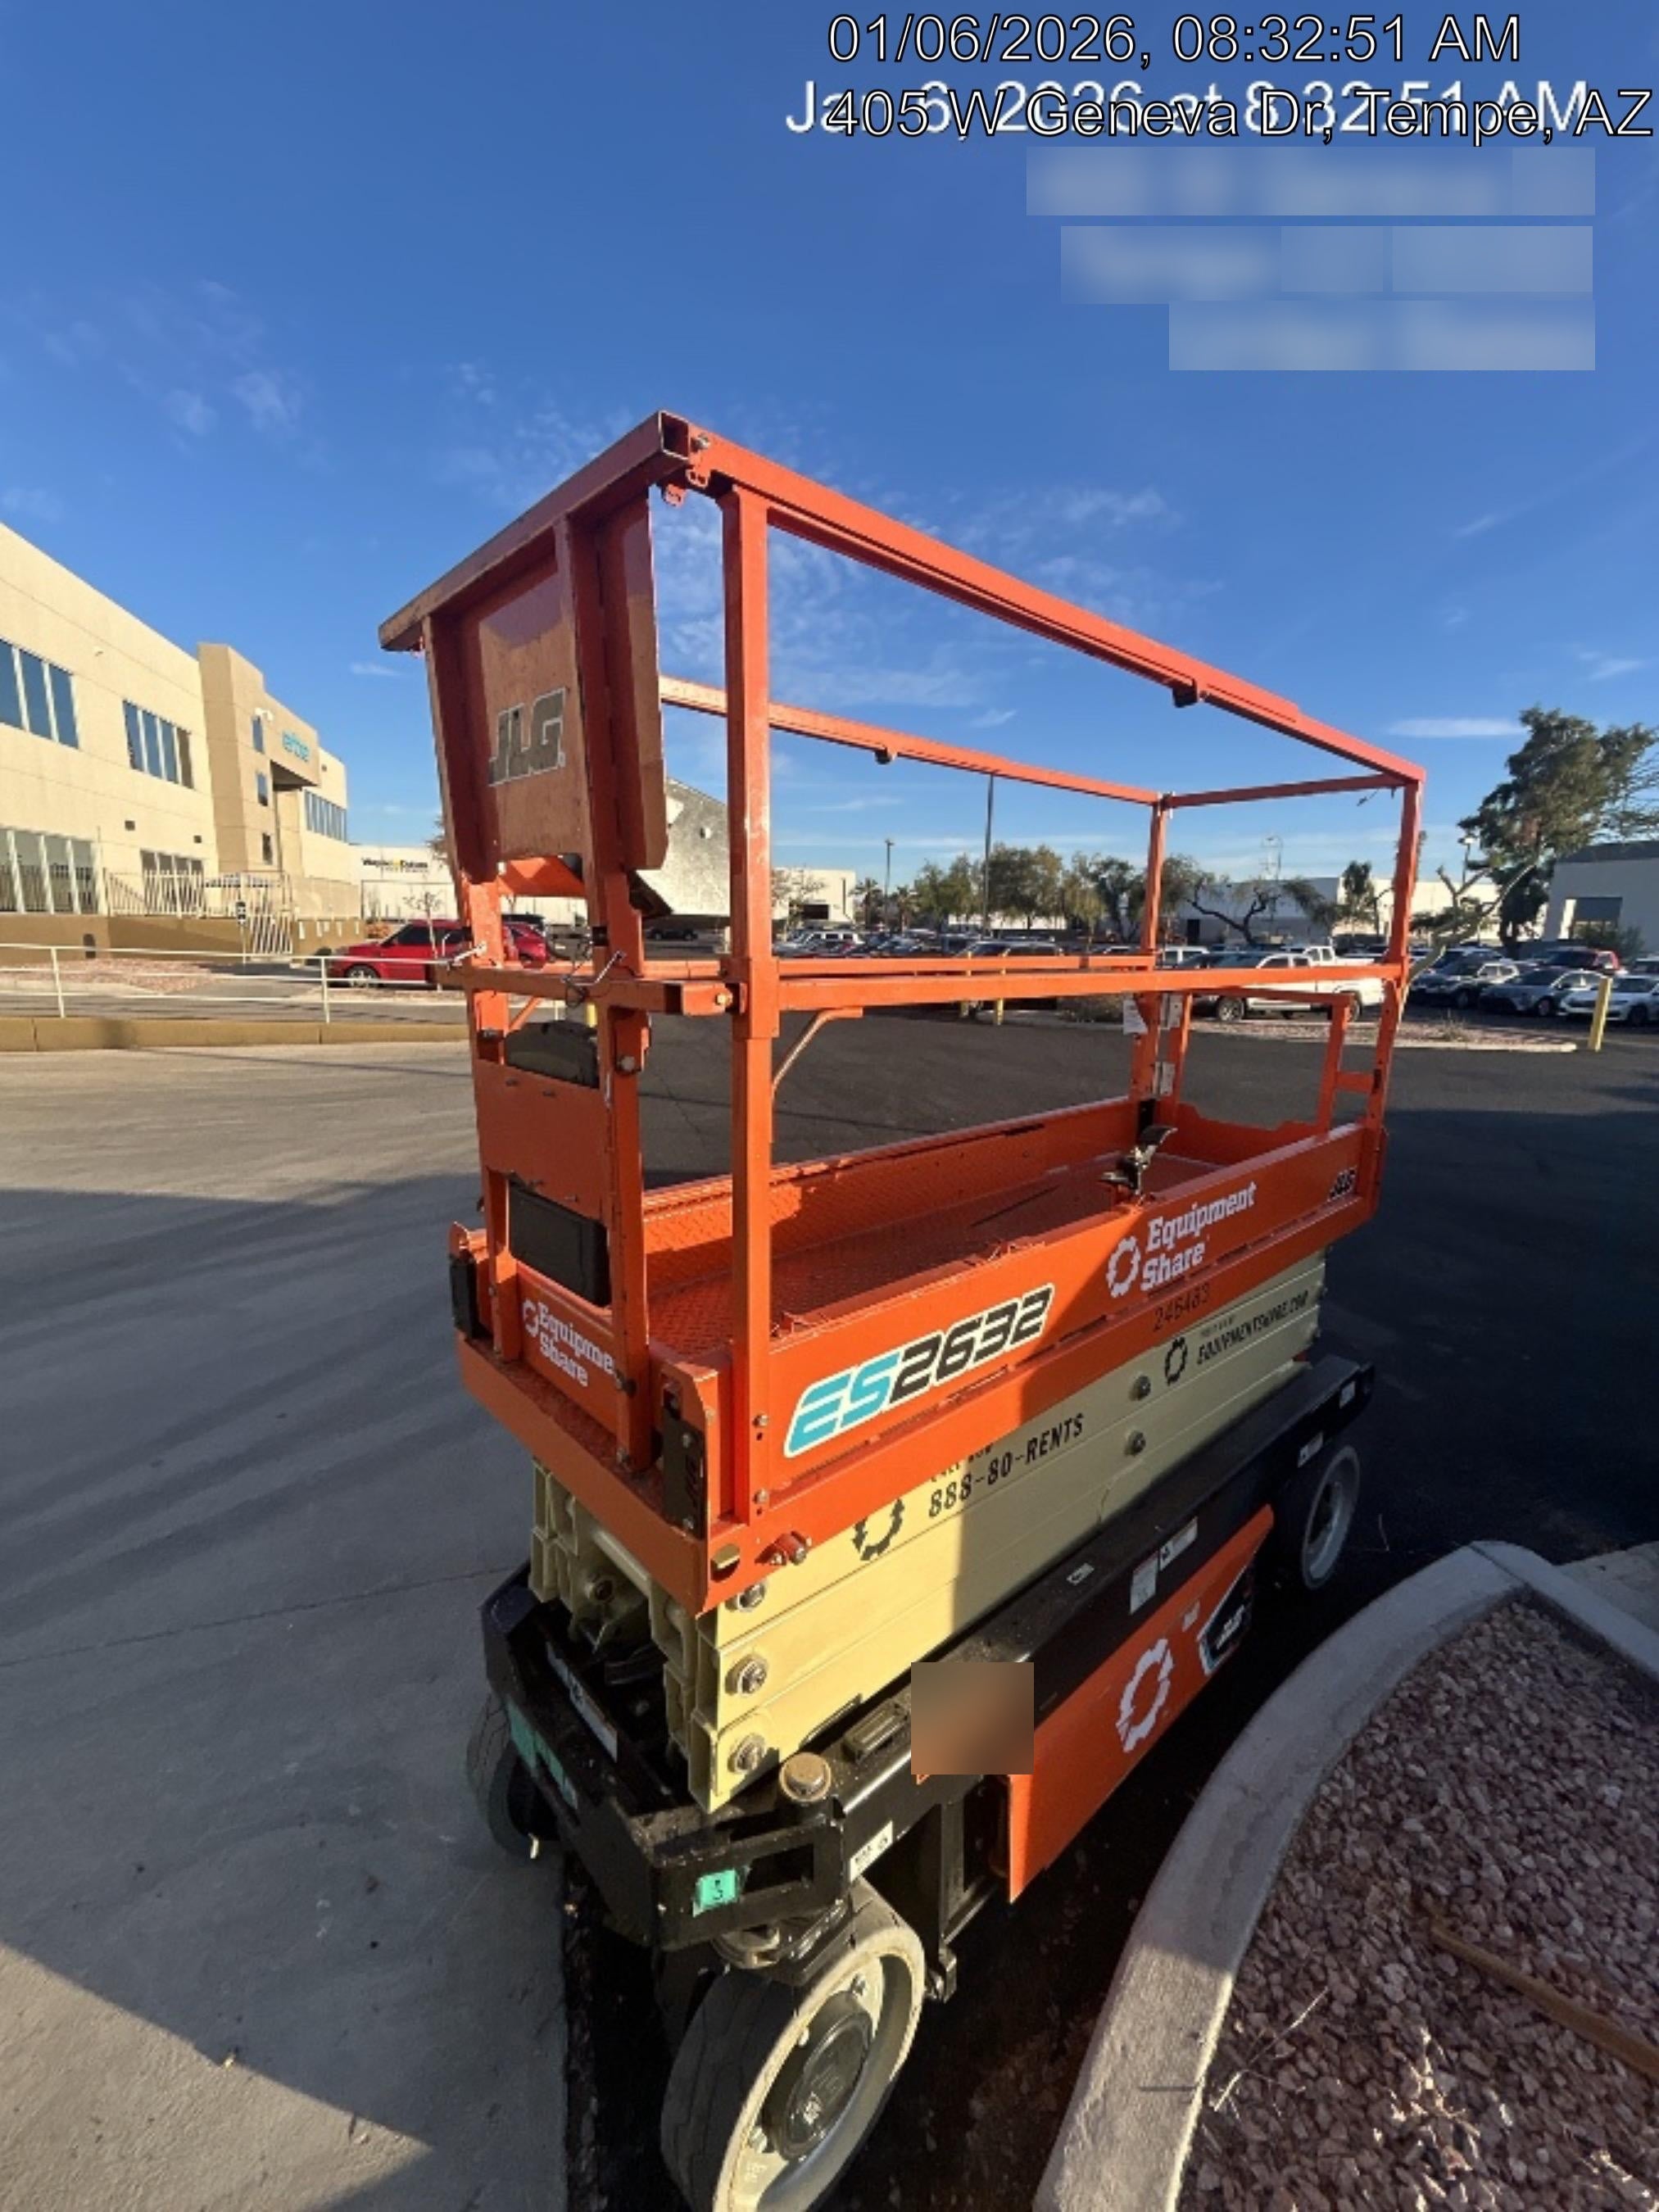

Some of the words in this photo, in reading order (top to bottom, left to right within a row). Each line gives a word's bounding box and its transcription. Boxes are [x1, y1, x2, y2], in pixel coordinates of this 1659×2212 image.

[487, 687, 566, 786] JLG
[1146, 1181, 1257, 1253] Equipment
[1140, 1241, 1205, 1291] Share
[537, 1301, 614, 1376] Equipme
[540, 1330, 588, 1387] Share
[783, 1282, 1055, 1457] ES2632
[928, 1412, 1085, 1518] 888-80-RENTS
